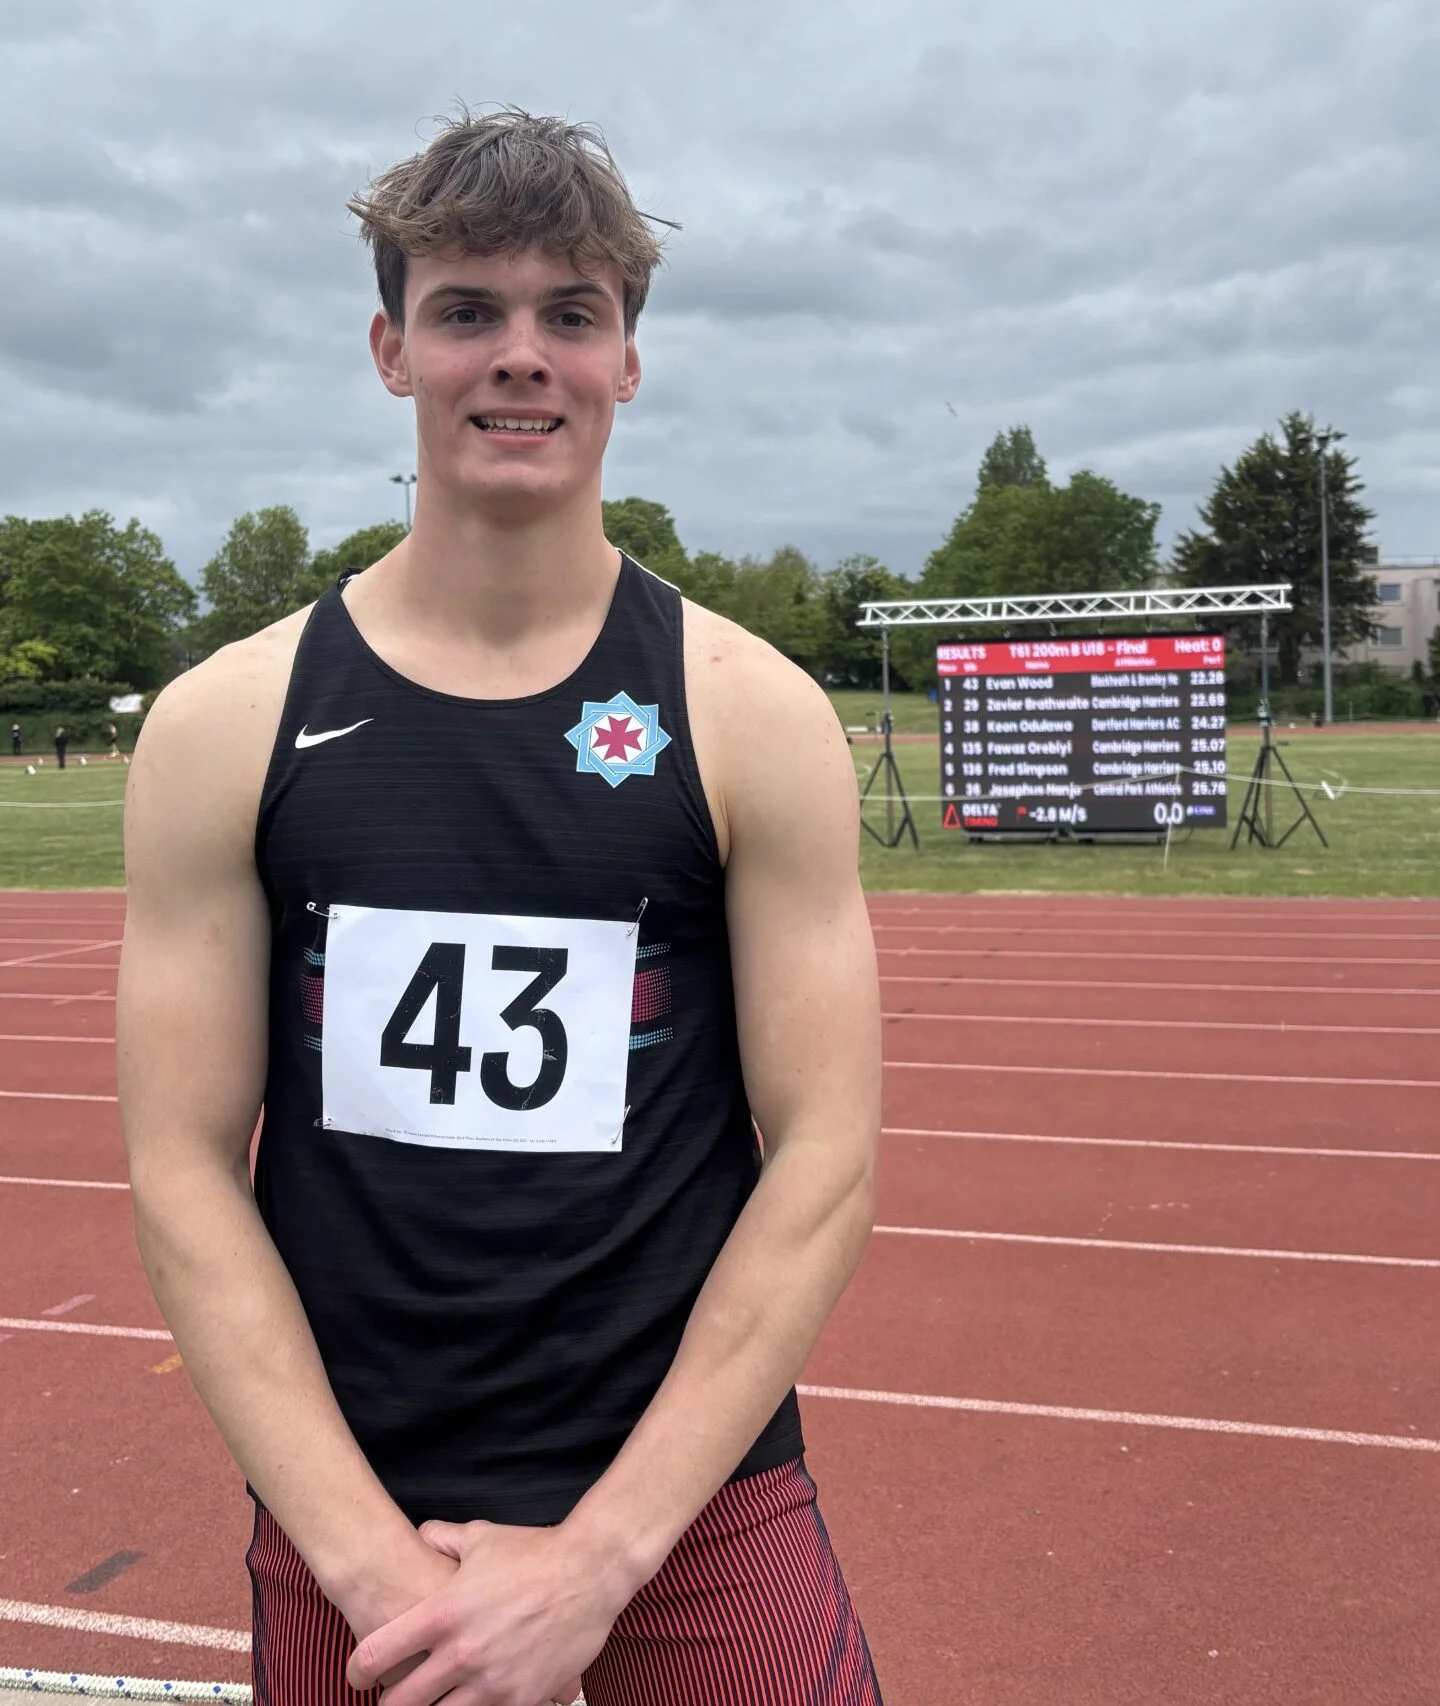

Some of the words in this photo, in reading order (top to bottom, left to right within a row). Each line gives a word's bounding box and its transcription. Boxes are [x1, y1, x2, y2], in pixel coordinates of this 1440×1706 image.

[937, 645, 986, 660] RESULTS
[1032, 643, 1069, 658] 200m
[1116, 640, 1148, 655] Final
[1174, 639, 1210, 654] Heat:
[1212, 637, 1221, 652] 0
[944, 678, 951, 691] 1
[962, 677, 979, 691] 43
[986, 677, 1016, 690] Evan
[1017, 676, 1053, 690] Wood
[944, 698, 952, 712] 2
[1025, 695, 1089, 711] Brathwaite
[1091, 695, 1140, 712] Cambridge
[1142, 693, 1179, 708] Harriers
[944, 720, 953, 734] 3
[1091, 717, 1128, 731] Dartford
[1129, 715, 1165, 731] Harriers
[1166, 716, 1180, 730] AC
[1191, 715, 1225, 730] 24.27
[944, 742, 954, 755] 4
[987, 741, 1026, 755] Fawaz
[1092, 740, 1141, 756] Cambridge
[1143, 738, 1180, 753] Harriers
[1191, 738, 1225, 752] 25.07
[945, 762, 954, 776] 5
[988, 762, 1015, 776] Fred
[1016, 761, 1068, 779] Simpson
[1092, 762, 1141, 778] Cambridge
[1143, 760, 1180, 775] Harriers
[1193, 760, 1225, 774] 25.10
[945, 783, 955, 797] 6
[1125, 782, 1143, 796] Park
[962, 803, 998, 817] DELTA
[1059, 803, 1088, 825] M/S
[1154, 802, 1184, 824] 0.0
[380, 942, 568, 1111] 43
